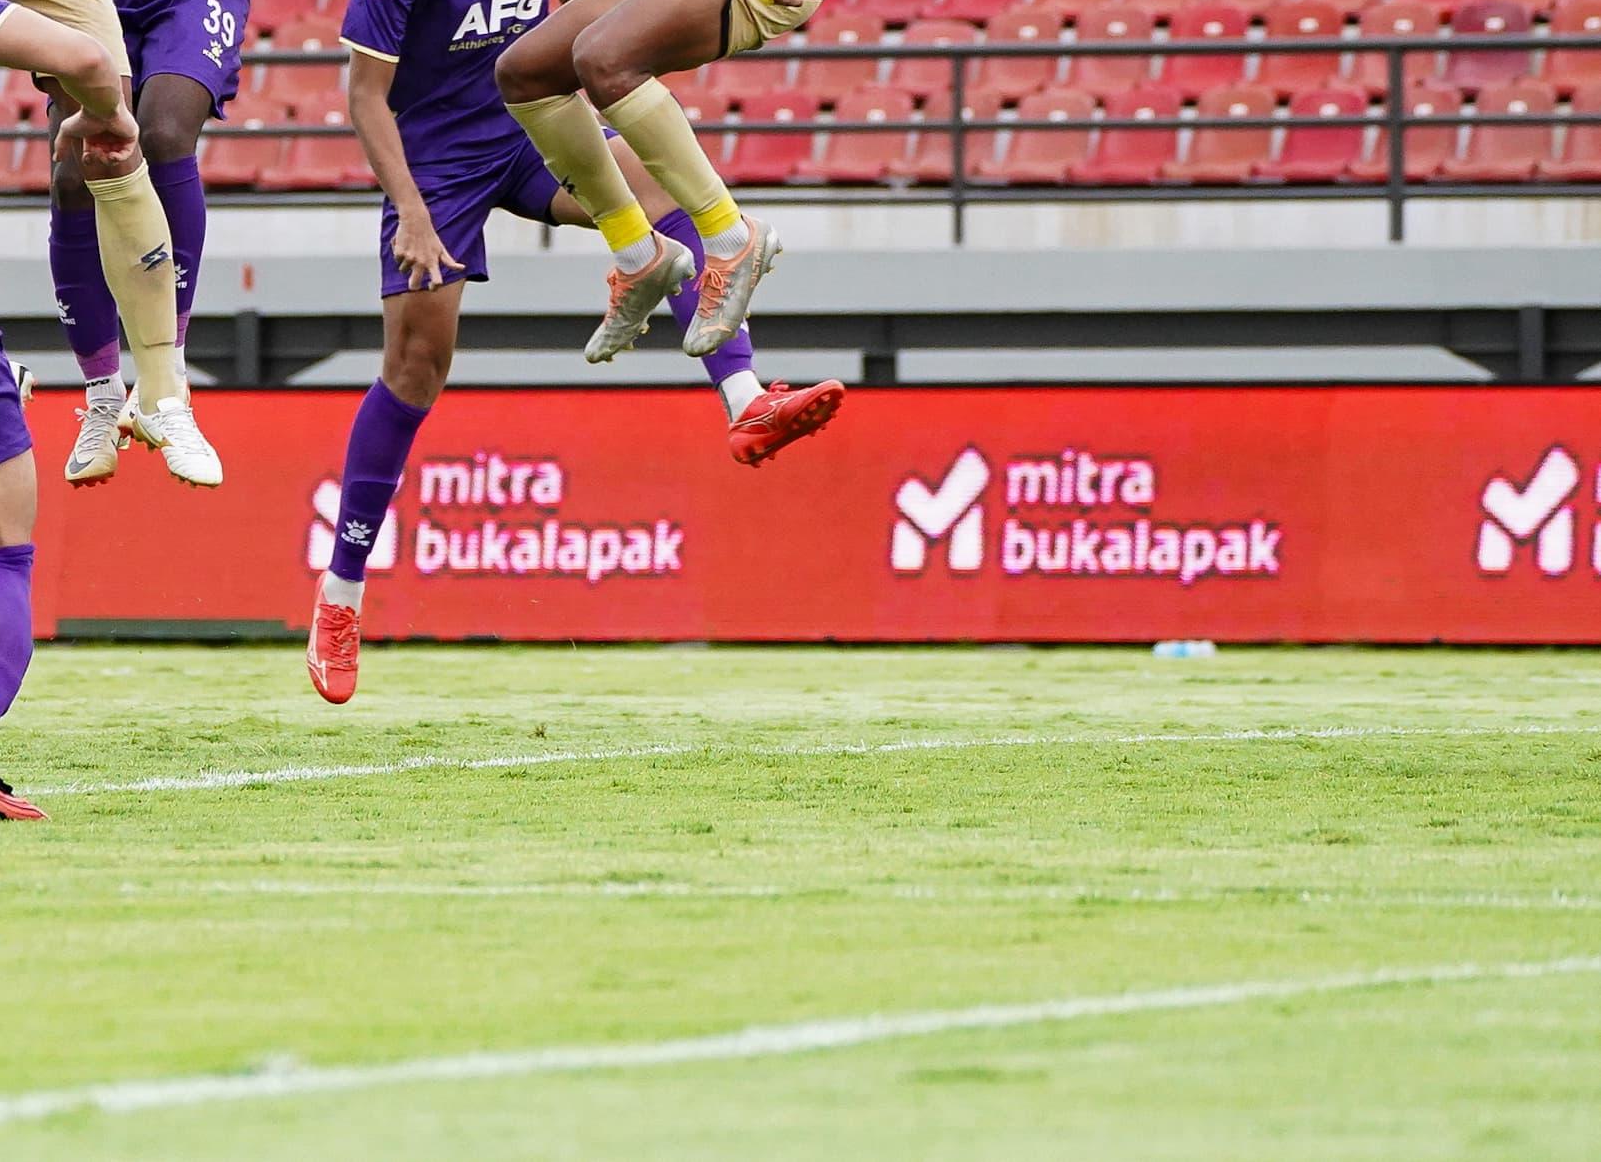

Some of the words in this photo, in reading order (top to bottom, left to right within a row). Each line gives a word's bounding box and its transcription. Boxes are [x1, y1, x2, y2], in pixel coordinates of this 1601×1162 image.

[419, 451, 564, 505] mitra
[1006, 447, 1155, 505] mitra
[414, 518, 684, 582] bukalapak
[1001, 518, 1282, 586] bukalapak
